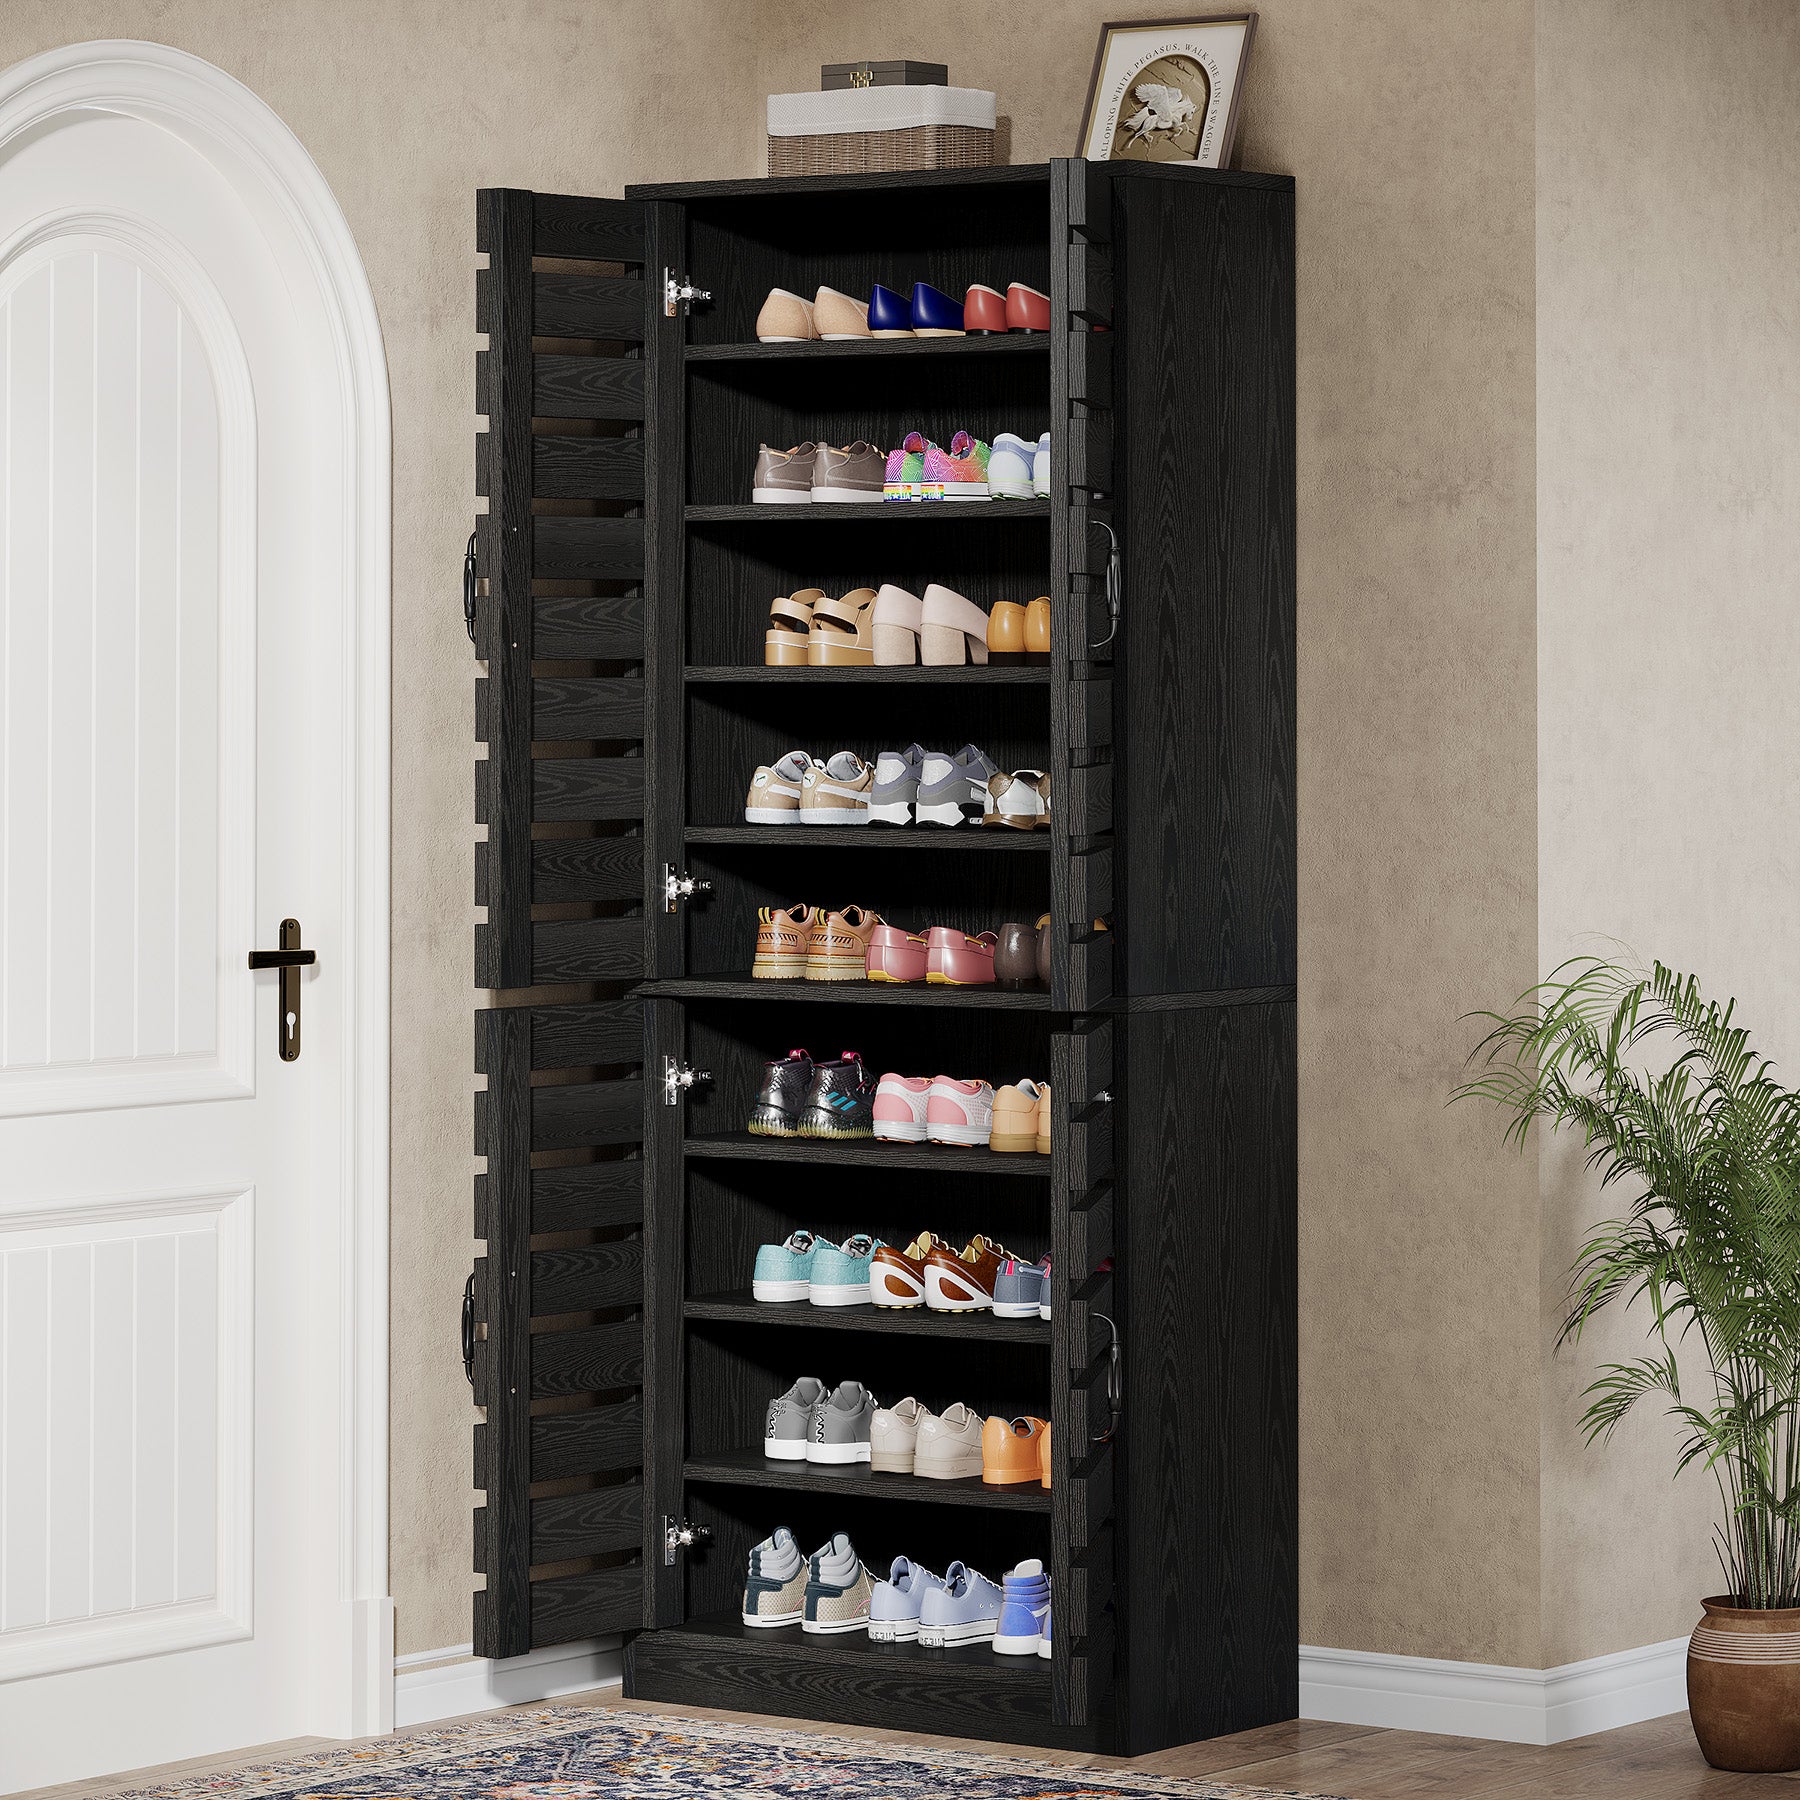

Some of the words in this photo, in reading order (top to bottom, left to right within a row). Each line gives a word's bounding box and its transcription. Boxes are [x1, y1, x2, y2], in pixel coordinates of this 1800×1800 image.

[1185, 43, 1210, 61] WALK
[1207, 58, 1220, 78] THE
[1112, 70, 1133, 102] WHITE
[1213, 80, 1222, 105] LINE
[1201, 109, 1218, 159] SWAGGER
